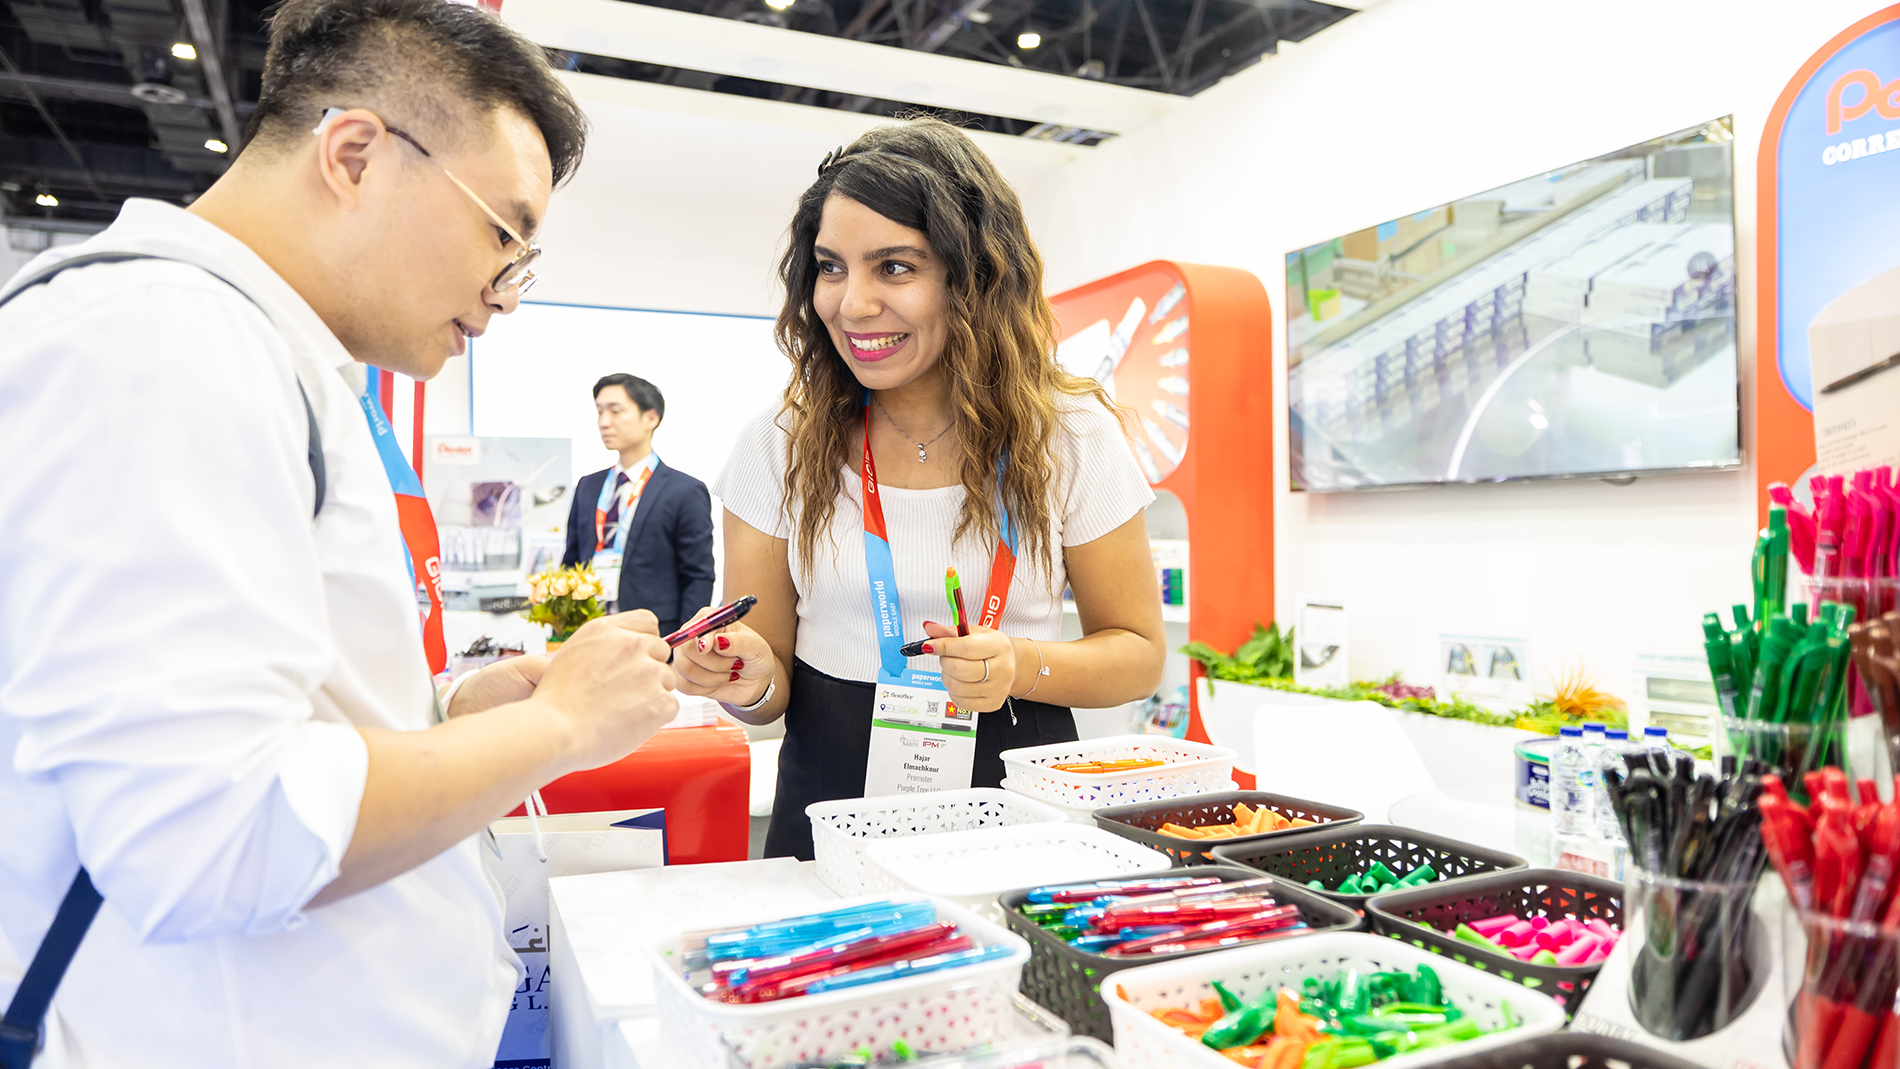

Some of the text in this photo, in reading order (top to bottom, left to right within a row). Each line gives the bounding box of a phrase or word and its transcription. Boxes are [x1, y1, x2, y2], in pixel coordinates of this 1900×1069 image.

[874, 580, 894, 638] paperworld
[890, 616, 900, 637] MIDDLE
[911, 673, 942, 683] paperwor
[913, 753, 931, 762] Hajar
[903, 762, 940, 773] Elmachkour
[906, 773, 933, 783] Promoter
[896, 783, 916, 793] Purple
